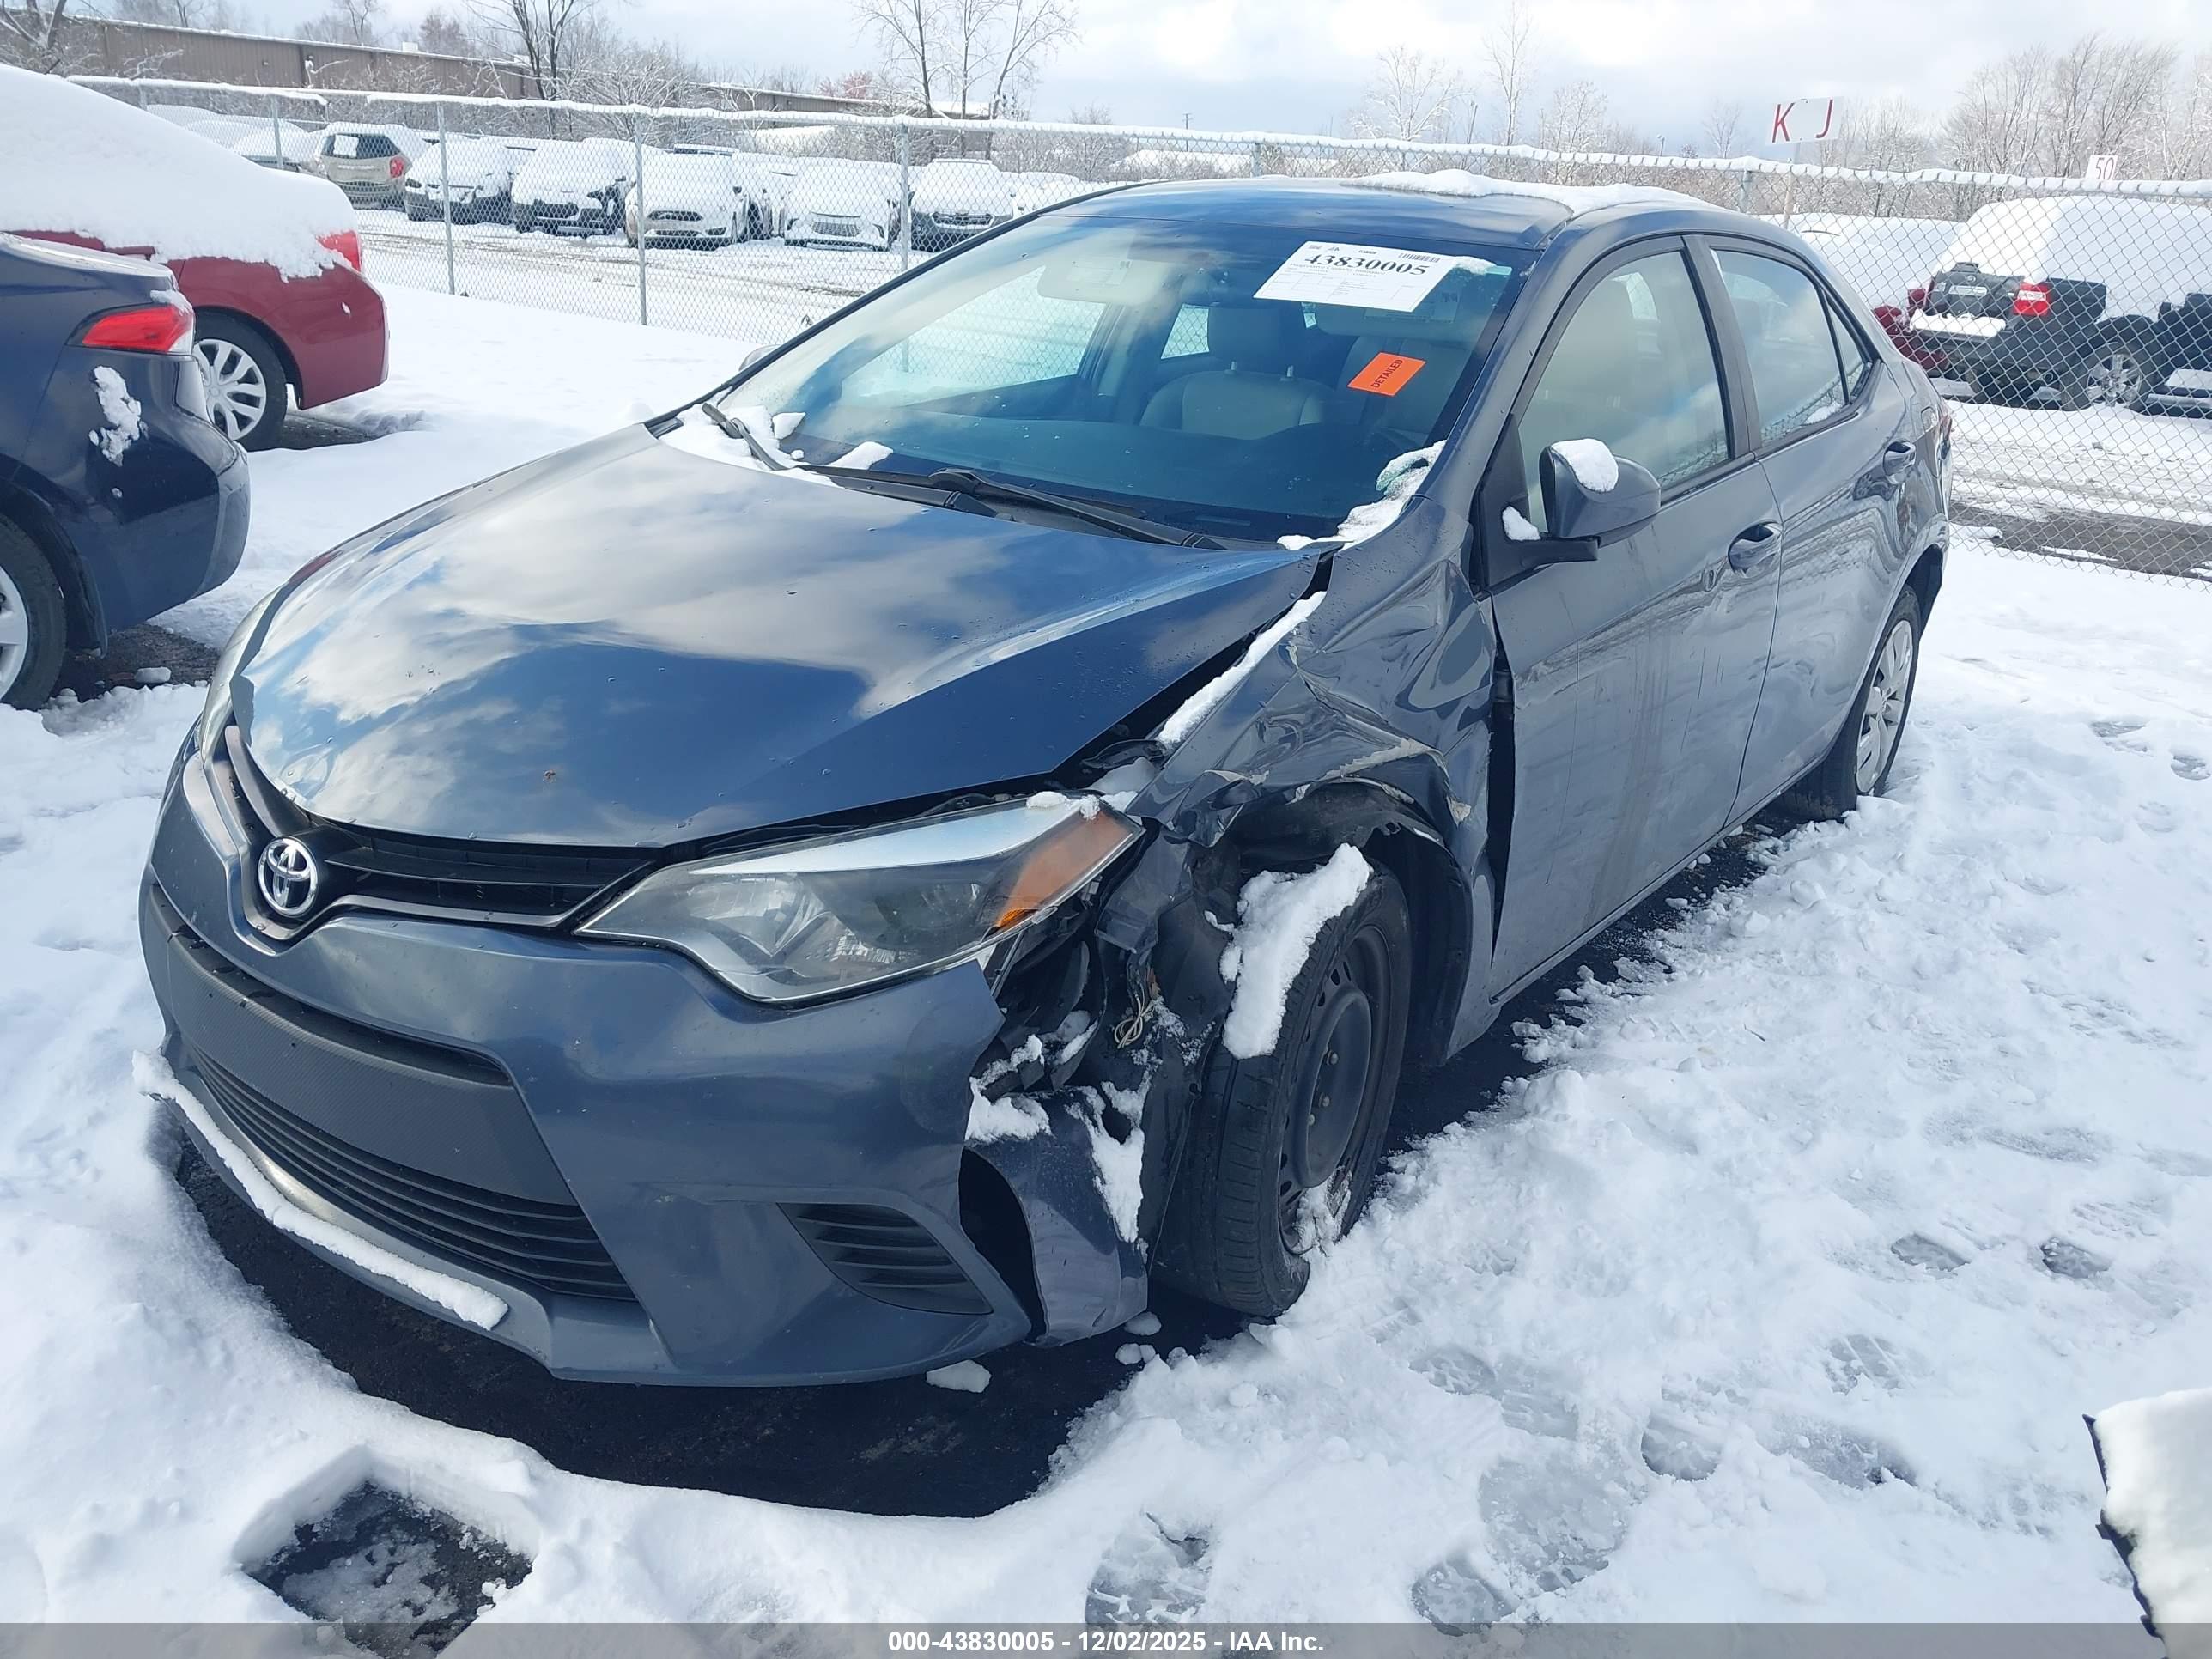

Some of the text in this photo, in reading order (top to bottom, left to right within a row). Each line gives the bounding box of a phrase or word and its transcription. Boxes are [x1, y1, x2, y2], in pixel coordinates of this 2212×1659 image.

[1772, 99, 1833, 143] K J
[2095, 157, 2114, 180] 50
[1304, 253, 1430, 275] 43830005
[1370, 359, 1403, 388] DETAILED
